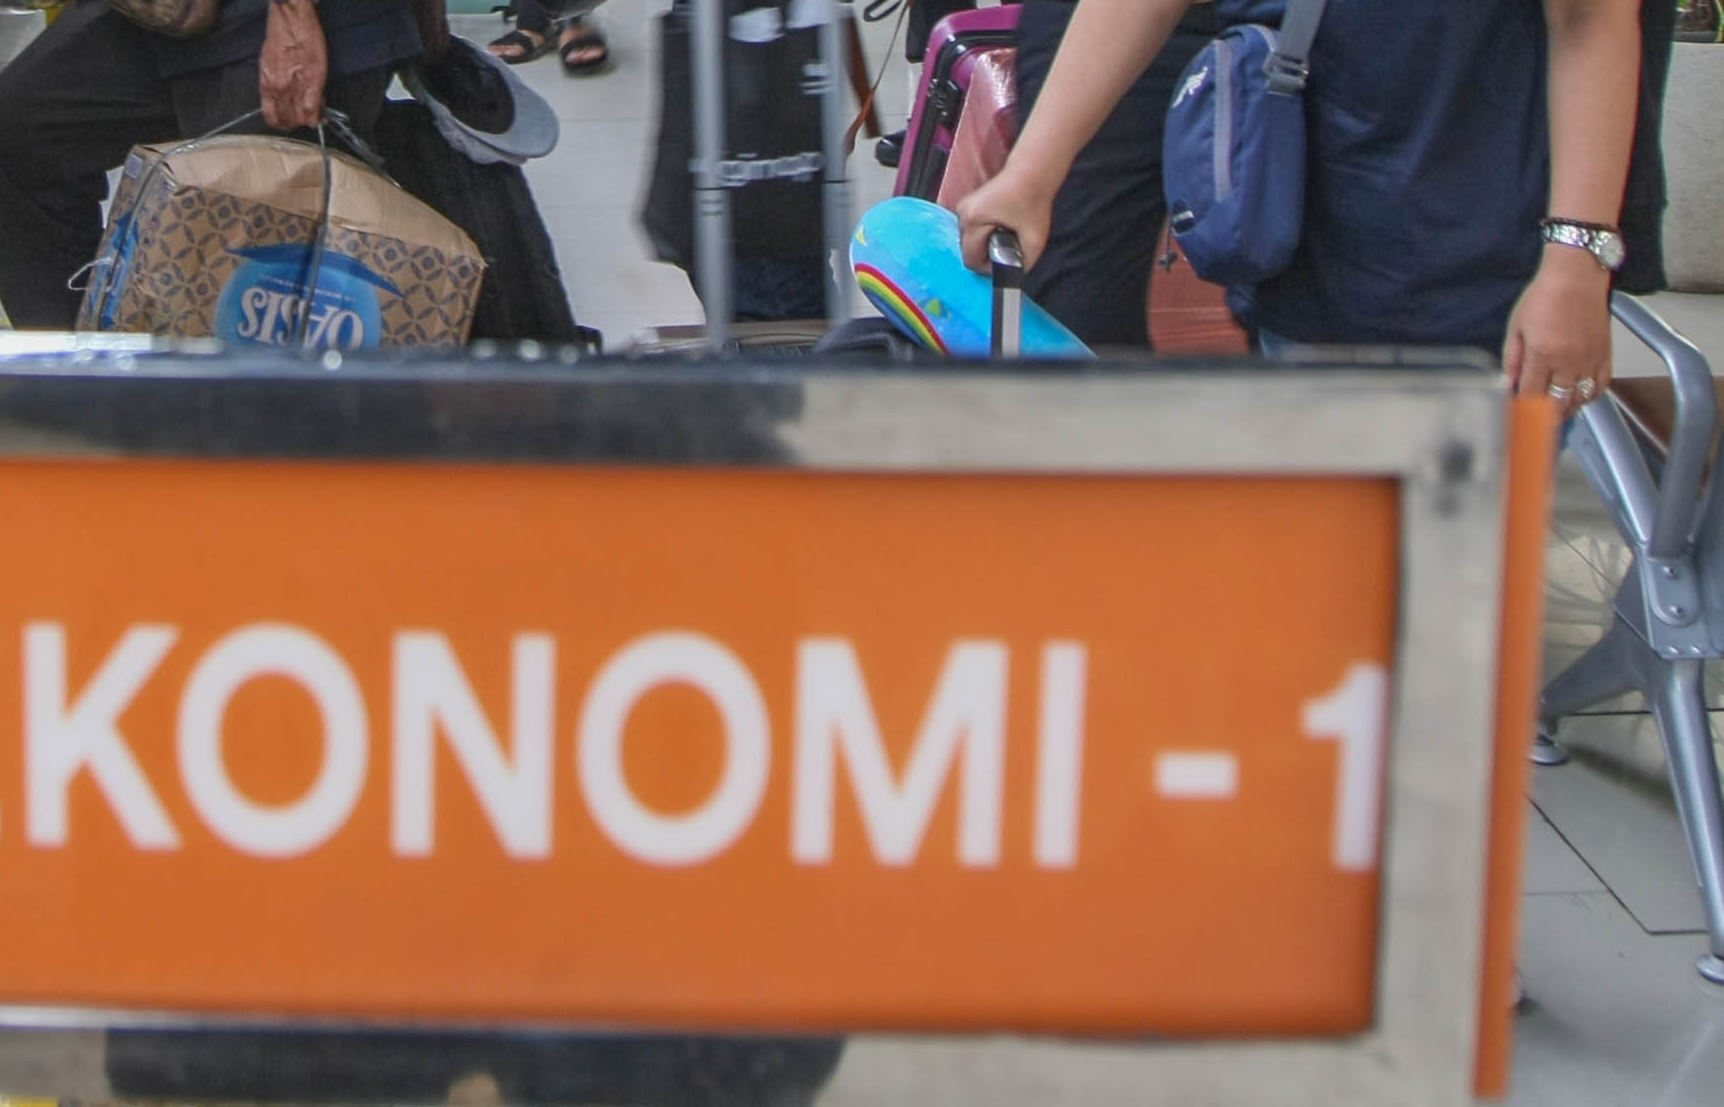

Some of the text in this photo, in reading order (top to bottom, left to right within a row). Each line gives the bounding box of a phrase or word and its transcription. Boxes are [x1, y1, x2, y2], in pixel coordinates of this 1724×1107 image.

[237, 287, 365, 353] OASIS
[1155, 750, 1238, 797] -
[1300, 662, 1390, 873] 1
